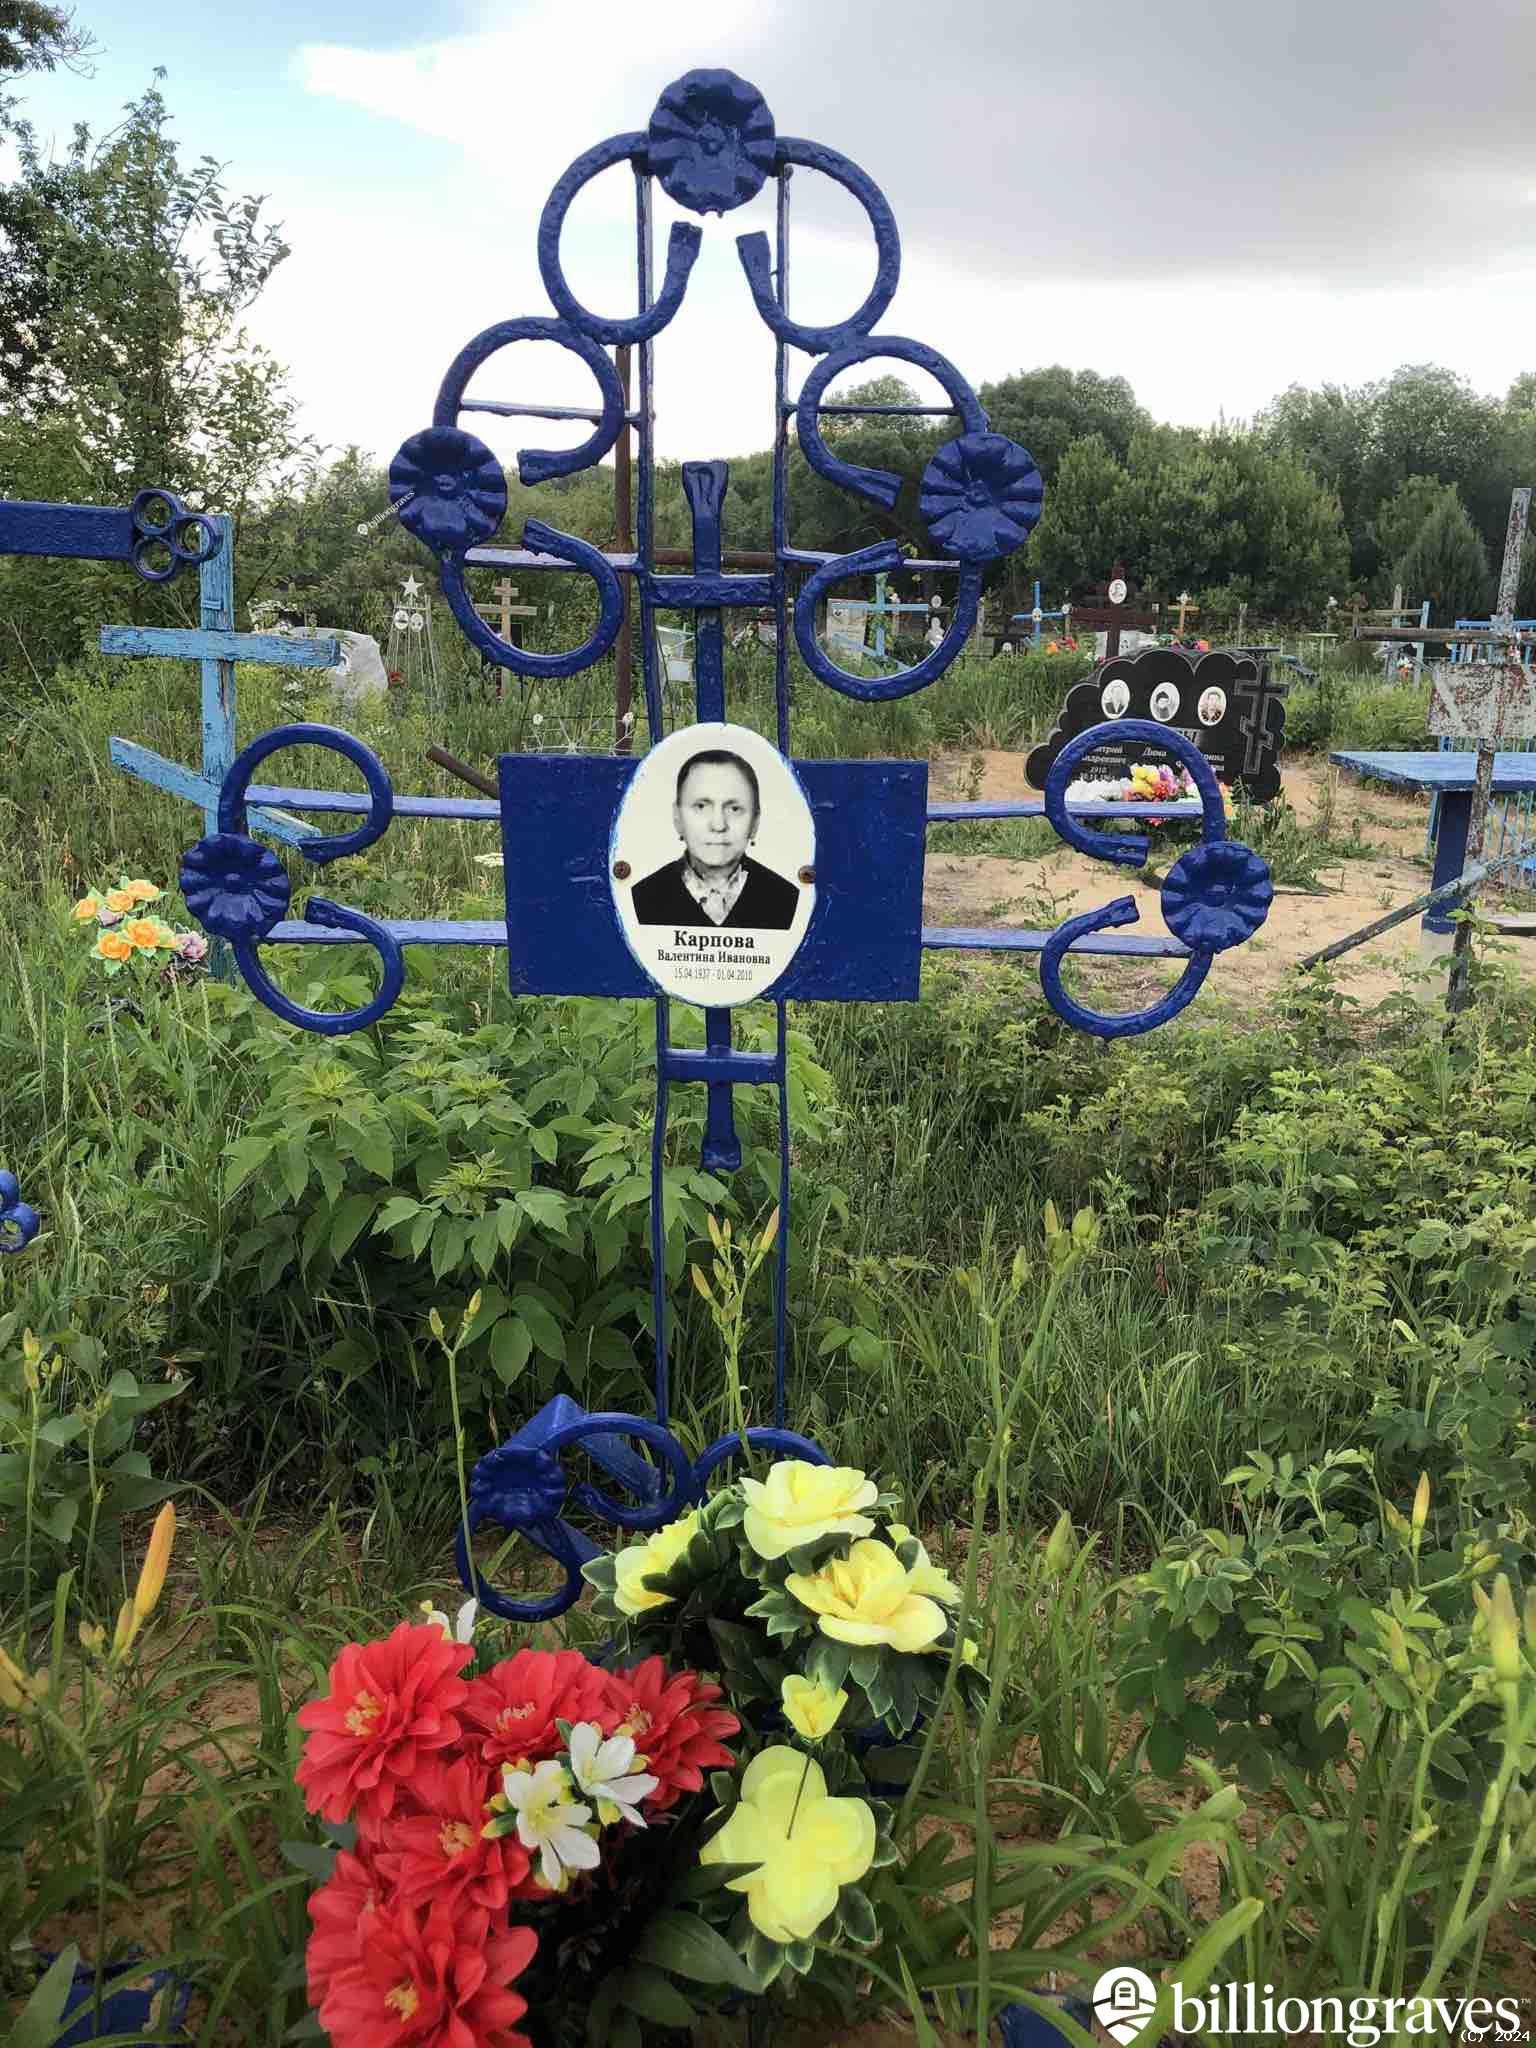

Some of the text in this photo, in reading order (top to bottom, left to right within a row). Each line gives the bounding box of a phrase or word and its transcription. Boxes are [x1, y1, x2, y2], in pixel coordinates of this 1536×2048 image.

[673, 930, 755, 951] Карпова
[657, 949, 771, 965] Валентина Ивановна
